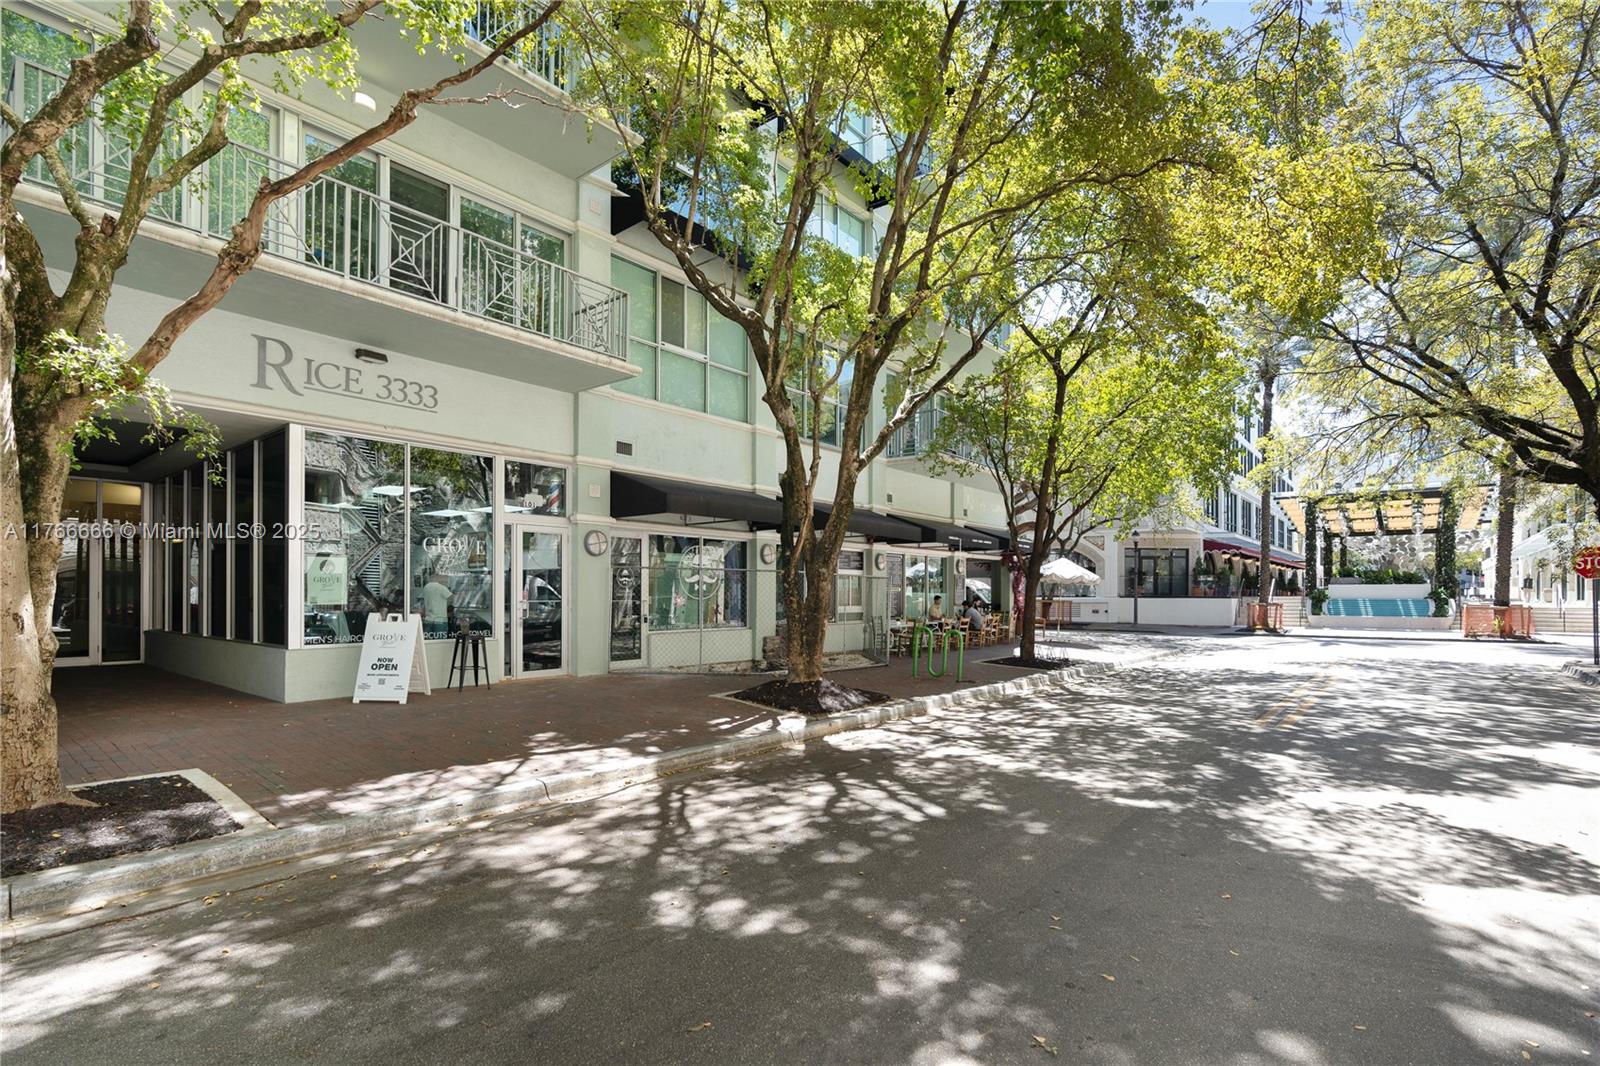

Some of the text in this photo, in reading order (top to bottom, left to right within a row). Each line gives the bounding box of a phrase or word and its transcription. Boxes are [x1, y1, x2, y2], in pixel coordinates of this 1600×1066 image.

[376, 375, 438, 409] 3333
[423, 535, 486, 558] GROVE
[1576, 557, 1600, 569] STO
[304, 634, 366, 644] MEN'S HAIRC
[372, 632, 407, 642] GROVE
[371, 663, 398, 671] OPEN
